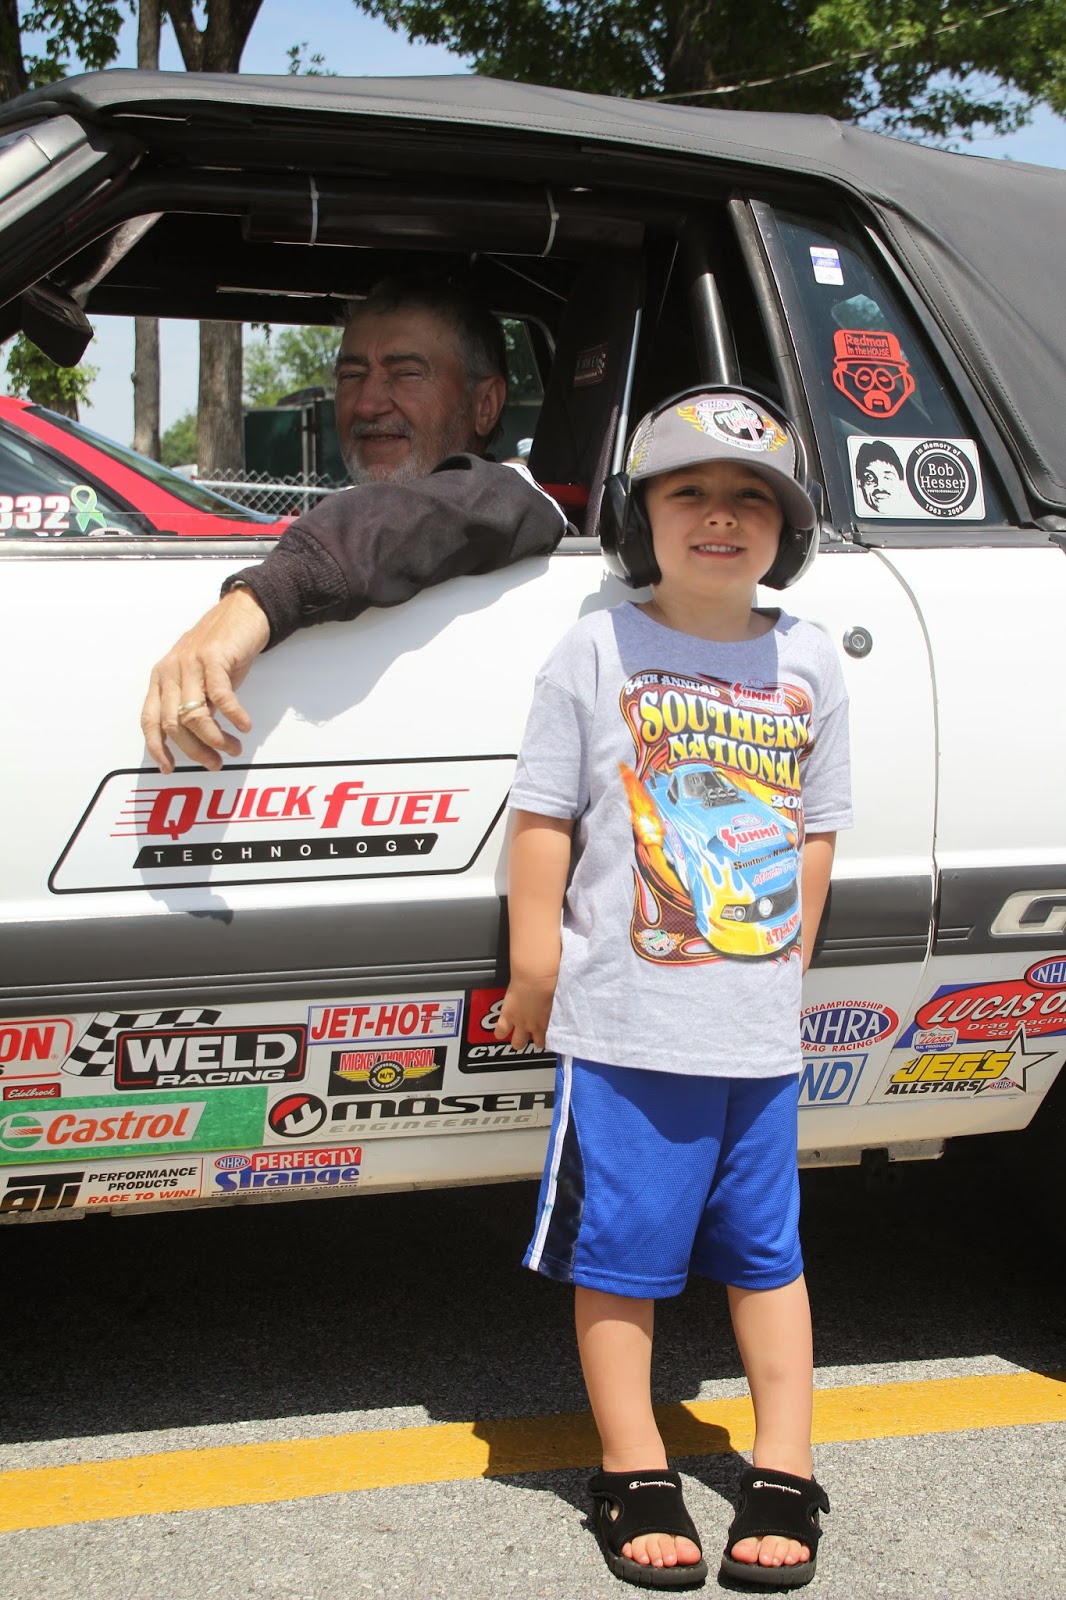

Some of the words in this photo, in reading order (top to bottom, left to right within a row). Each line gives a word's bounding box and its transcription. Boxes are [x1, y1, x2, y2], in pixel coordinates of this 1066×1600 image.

[845, 334, 888, 348] Redman
[855, 346, 867, 355] the
[867, 347, 891, 356] HOUSE
[915, 448, 924, 456] In
[923, 442, 951, 452] Memory
[952, 448, 961, 456] of
[927, 463, 954, 476] Bob
[920, 476, 965, 489] Hesser
[925, 504, 942, 515] 1963
[948, 505, 963, 516] 2009
[625, 674, 659, 695] 34TH
[661, 675, 720, 697] ANNUAL
[640, 689, 810, 750] SOUTHERN
[148, 786, 316, 840] QUICK
[155, 839, 426, 863] TECHNOLOGY
[733, 853, 772, 870] Southern
[805, 1000, 883, 1015] CHAMPIONSHIP
[927, 992, 1044, 1024] LUCAS
[311, 1003, 440, 1040] JET-HOT
[801, 1009, 880, 1043] NHRA
[966, 1022, 1009, 1032] Drag
[986, 1028, 1042, 1038] Seres
[126, 1033, 298, 1073] WELD
[468, 1043, 553, 1058] CYLIN
[832, 1039, 873, 1052] RACING
[340, 1051, 379, 1071] MICKEY
[381, 1048, 435, 1068] THOMPSON
[892, 1049, 1016, 1083] JEG'S
[156, 1069, 285, 1086] RACING
[994, 1081, 1013, 1089] NHRA
[8, 1087, 56, 1098] Edelbrock
[885, 1081, 980, 1095] ALLSTARS
[332, 1091, 554, 1120] MOSER
[46, 1107, 190, 1145] Castrol
[329, 1114, 533, 1133] ENGINEERING
[218, 1158, 247, 1168] NHRA
[256, 1148, 359, 1171] PERFECTLY
[88, 1167, 198, 1183] PERFORMANCE
[212, 1166, 360, 1193] Strange
[108, 1178, 178, 1191] PRODUCTS
[87, 1194, 129, 1204] RACE
[135, 1192, 155, 1201] TO
[159, 1189, 197, 1199] WIN!
[629, 1480, 676, 1490] Champion
[752, 1480, 801, 1495] Champion
